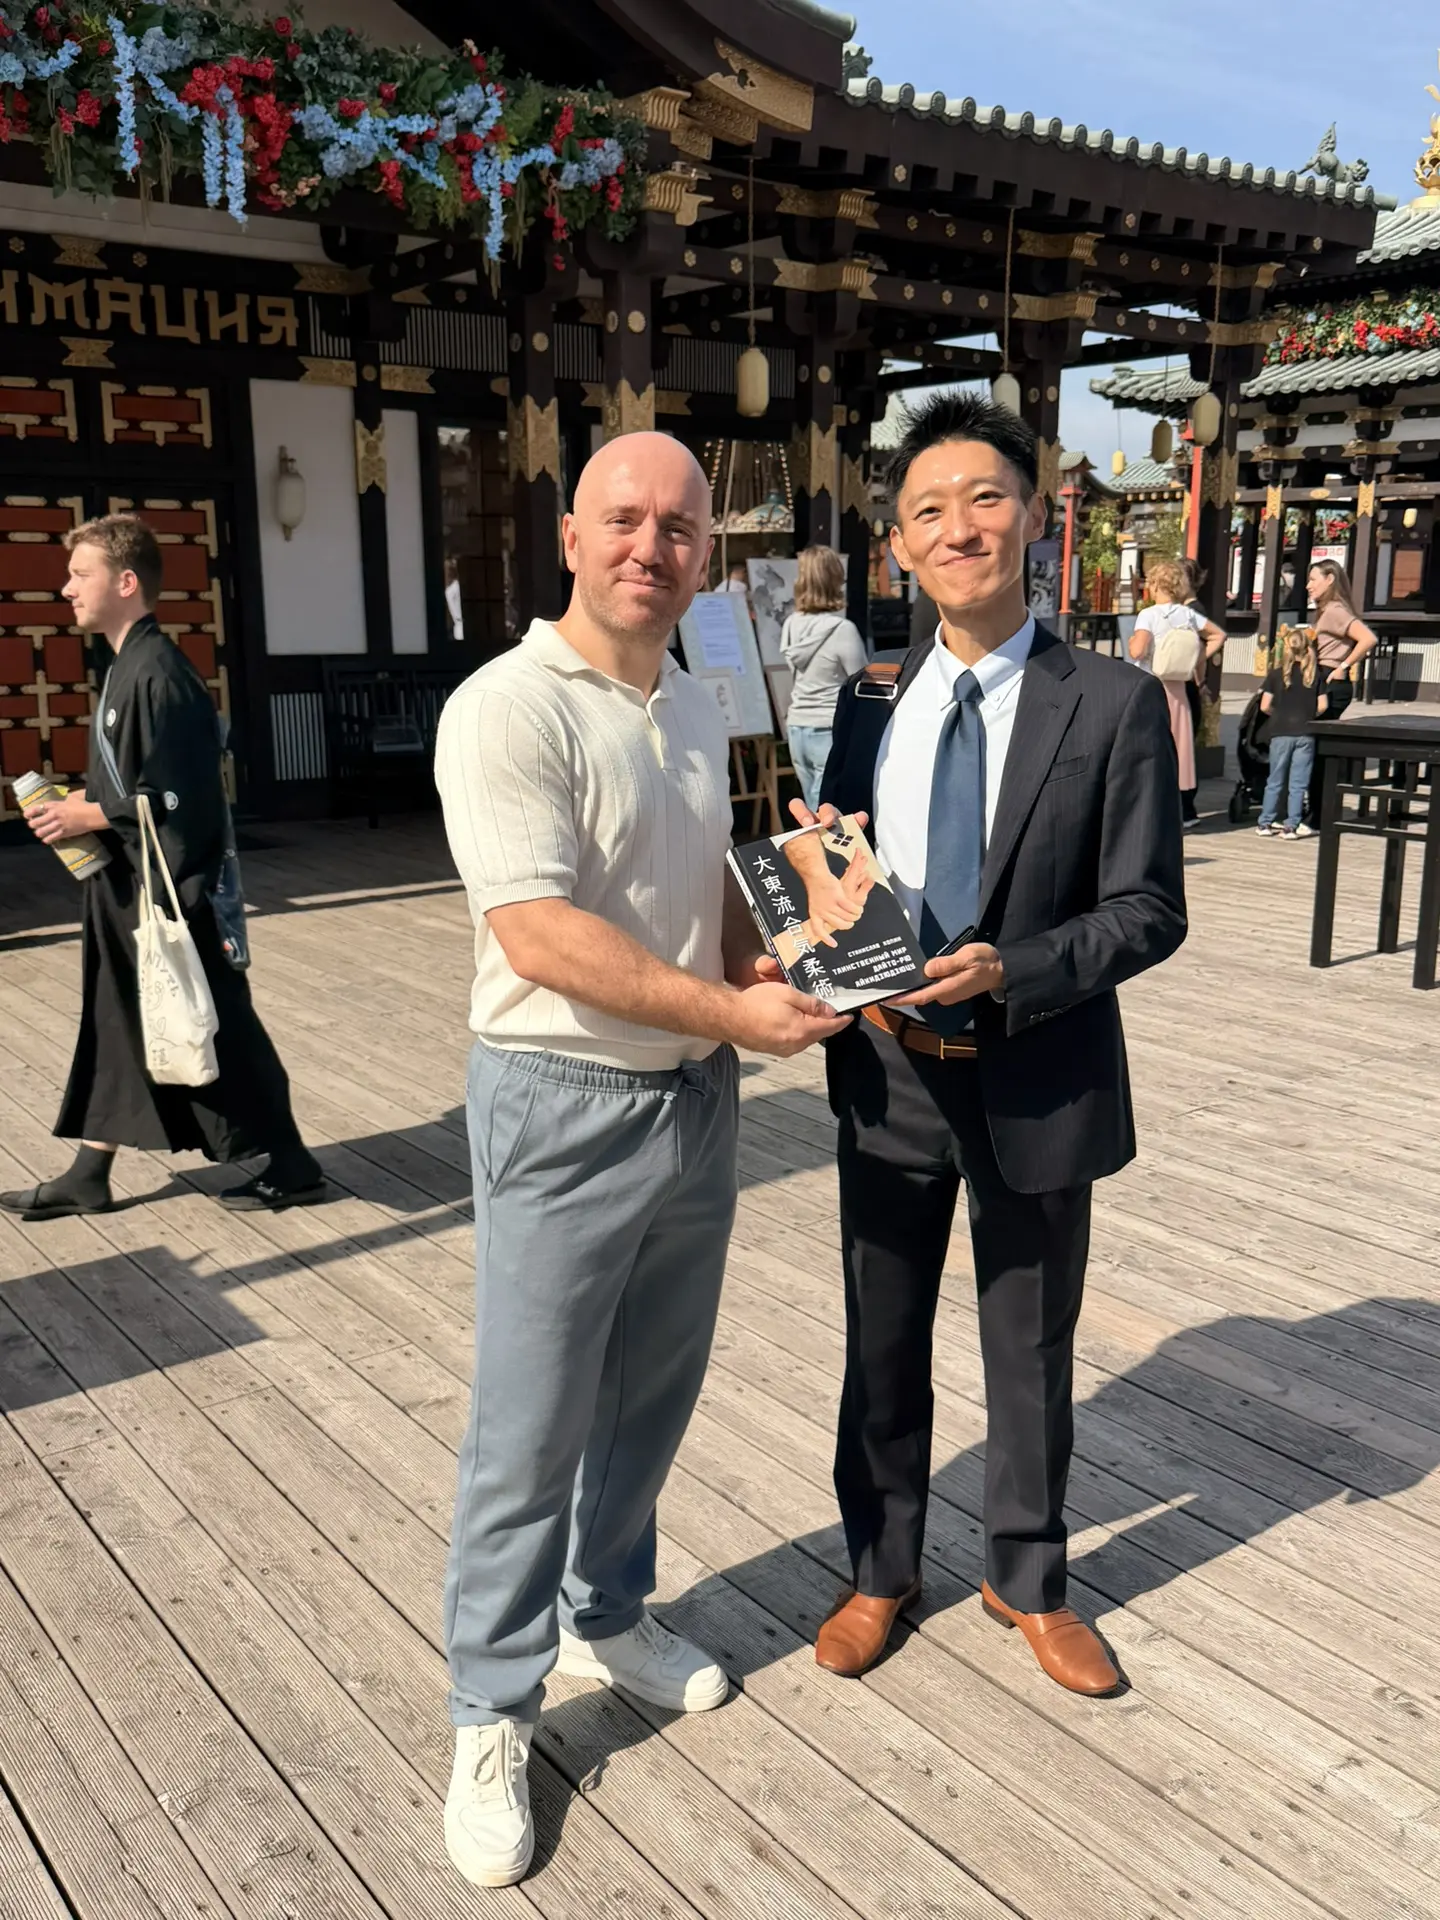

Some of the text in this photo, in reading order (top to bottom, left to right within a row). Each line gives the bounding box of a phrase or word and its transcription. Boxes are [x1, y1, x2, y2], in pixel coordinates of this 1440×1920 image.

[752, 855, 835, 999] 大東流合気柔術
[831, 946, 908, 976] ТАИНСТВЕННЫЙ МИР
[847, 943, 881, 958] СТАНИСЛАВ
[872, 954, 912, 973] ДАЙТО-РЮ
